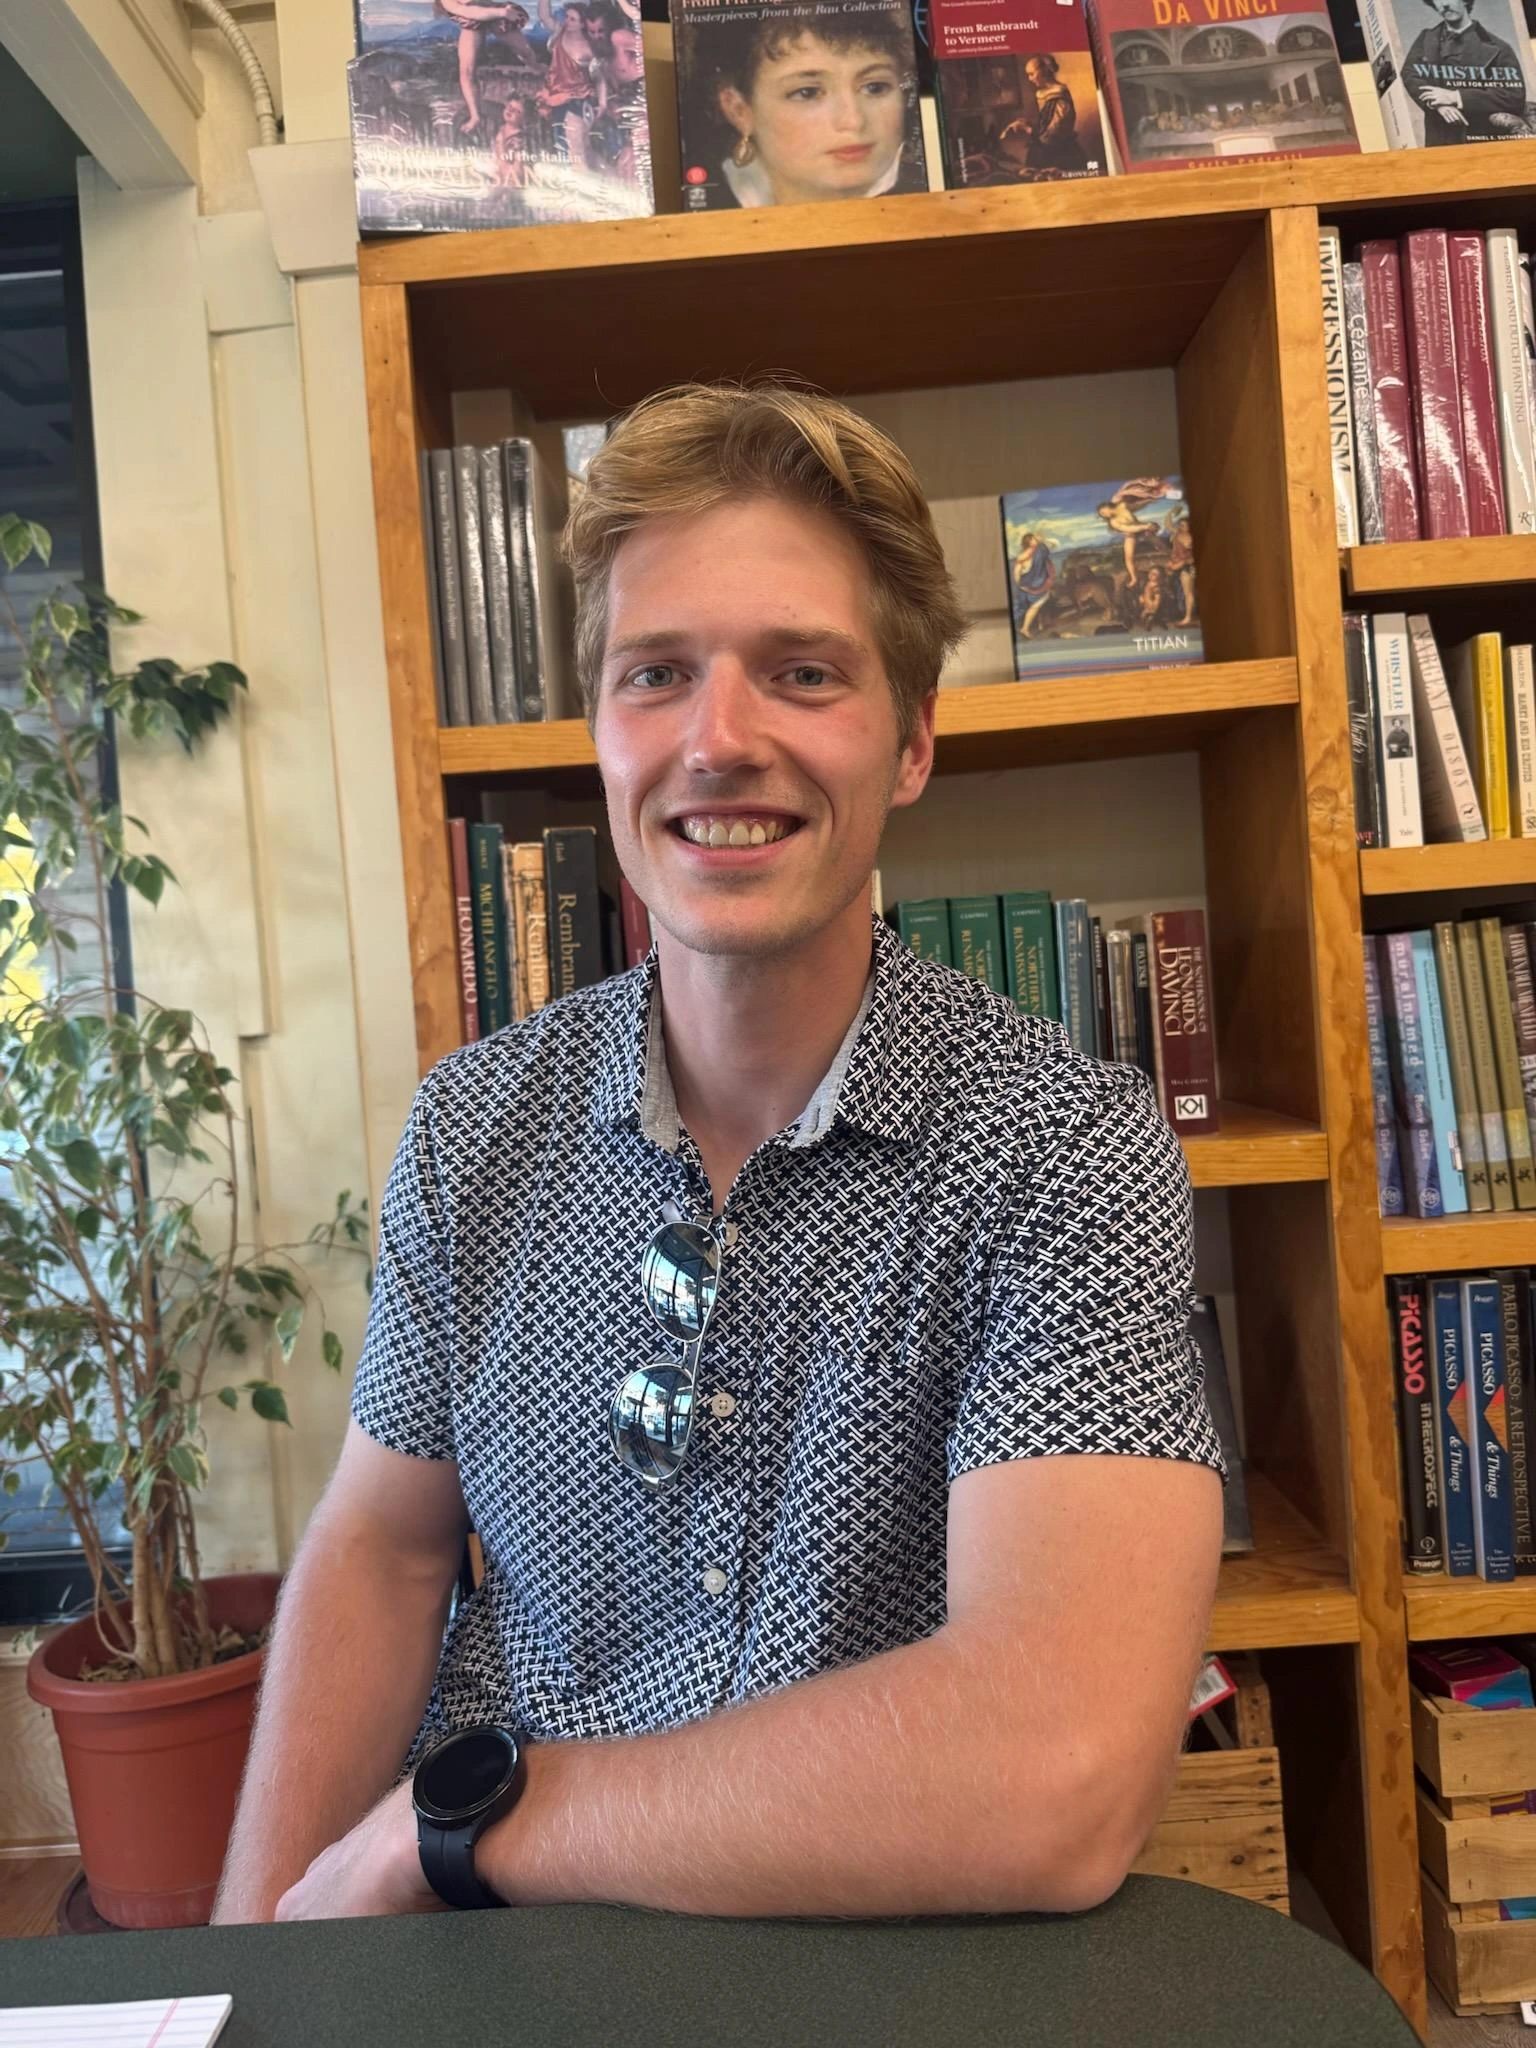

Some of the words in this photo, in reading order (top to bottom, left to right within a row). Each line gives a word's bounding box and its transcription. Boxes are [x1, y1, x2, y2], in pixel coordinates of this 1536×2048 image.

[683, 9, 758, 24] Masterpieces
[759, 7, 790, 20] from
[793, 6, 812, 16] the
[815, 4, 839, 14] Rau
[843, 0, 902, 12] Collection
[943, 25, 974, 35] From
[976, 20, 1039, 33] Rembrandt
[945, 37, 957, 46] to
[958, 34, 1006, 45] Vermeer
[1413, 63, 1521, 81] WHISTLER
[503, 149, 514, 162] of
[516, 149, 538, 163] the
[1437, 270, 1449, 315] PRIVATE
[1319, 237, 1352, 473] IMPRESSIONISM
[1350, 312, 1369, 399] Cézanne
[1389, 328, 1401, 373] PASSION
[1441, 318, 1452, 363] PASSION
[1511, 366, 1525, 423] PAINTING
[1133, 635, 1188, 652] TITIAN
[1390, 637, 1405, 710] WHISTLER
[1412, 629, 1453, 712] SARGENT
[1442, 731, 1469, 789] OLSON
[457, 896, 478, 1004] LEONARDO
[480, 883, 498, 1000] MICHELANGELO
[1178, 946, 1197, 1035] LEONARDO
[1502, 1285, 1518, 1331] PABLO
[1443, 1327, 1457, 1391] PICASSO
[1479, 1331, 1494, 1396] PICASSO
[1504, 1335, 1521, 1400] PICASSO:
[1511, 1405, 1523, 1416] A
[1449, 1436, 1461, 1447] &
[1485, 1441, 1498, 1453] &
[1450, 1449, 1463, 1493] Things
[1486, 1454, 1500, 1499] Things
[1511, 1421, 1531, 1544] RETROSPECTIVE
[1413, 1558, 1441, 1568] Praeger
